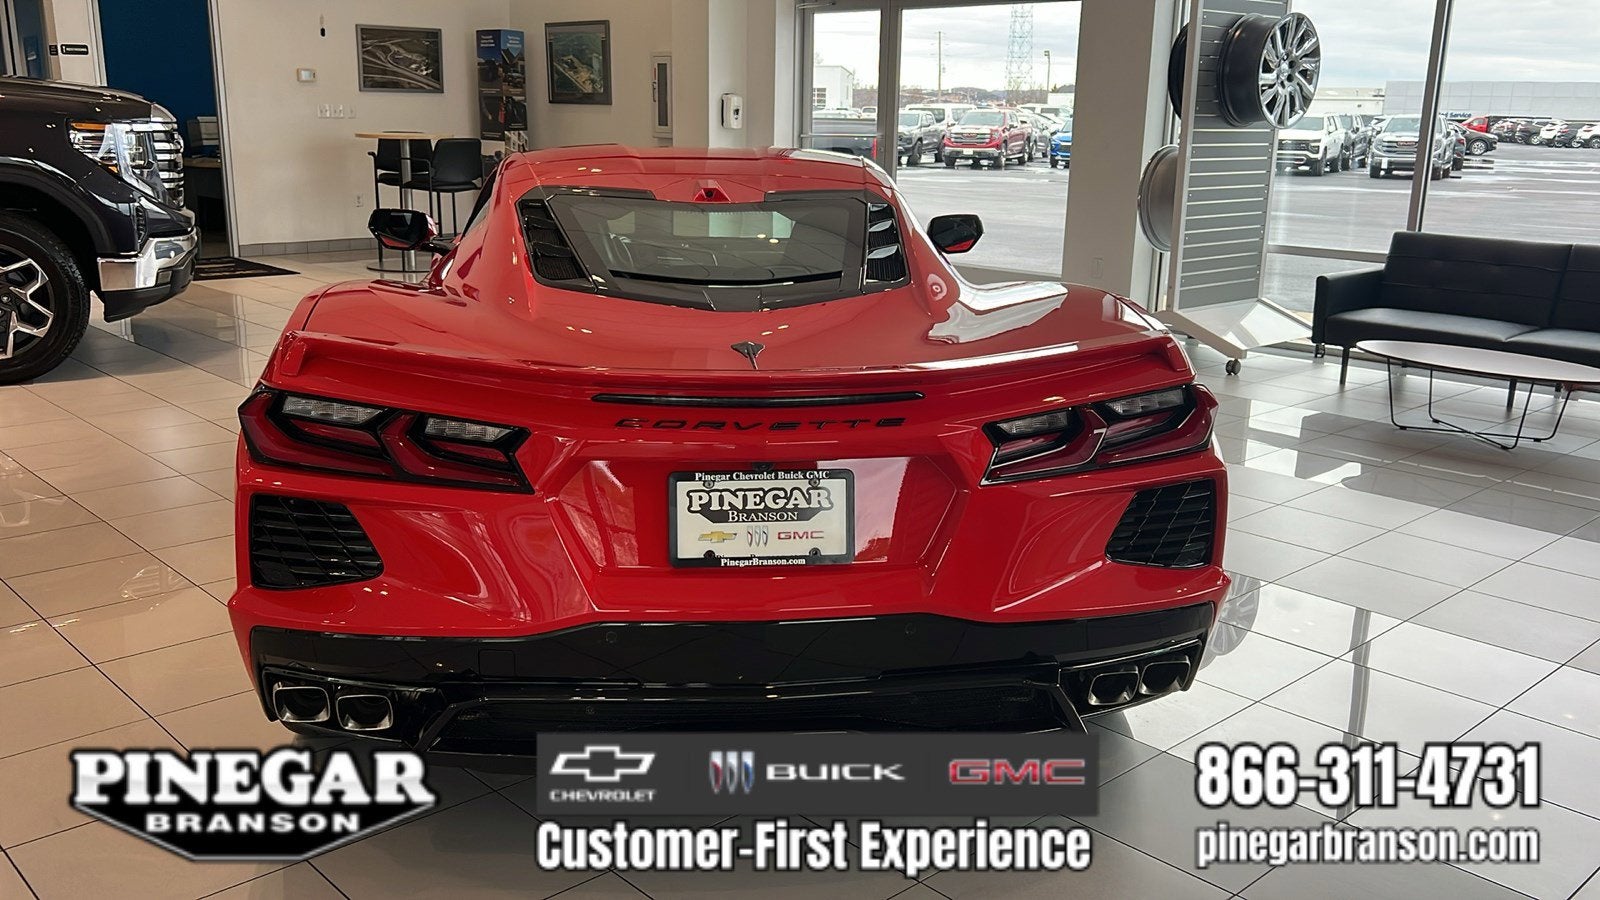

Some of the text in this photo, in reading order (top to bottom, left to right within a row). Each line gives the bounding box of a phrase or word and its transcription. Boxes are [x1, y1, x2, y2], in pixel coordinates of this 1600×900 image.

[615, 417, 906, 431] CORVETTE
[695, 471, 830, 482] Pinegar Chevrolet Buick GMC
[689, 490, 831, 511] PINEGAR
[777, 531, 825, 540] GMC
[720, 557, 806, 567] PinegarBranson.com
